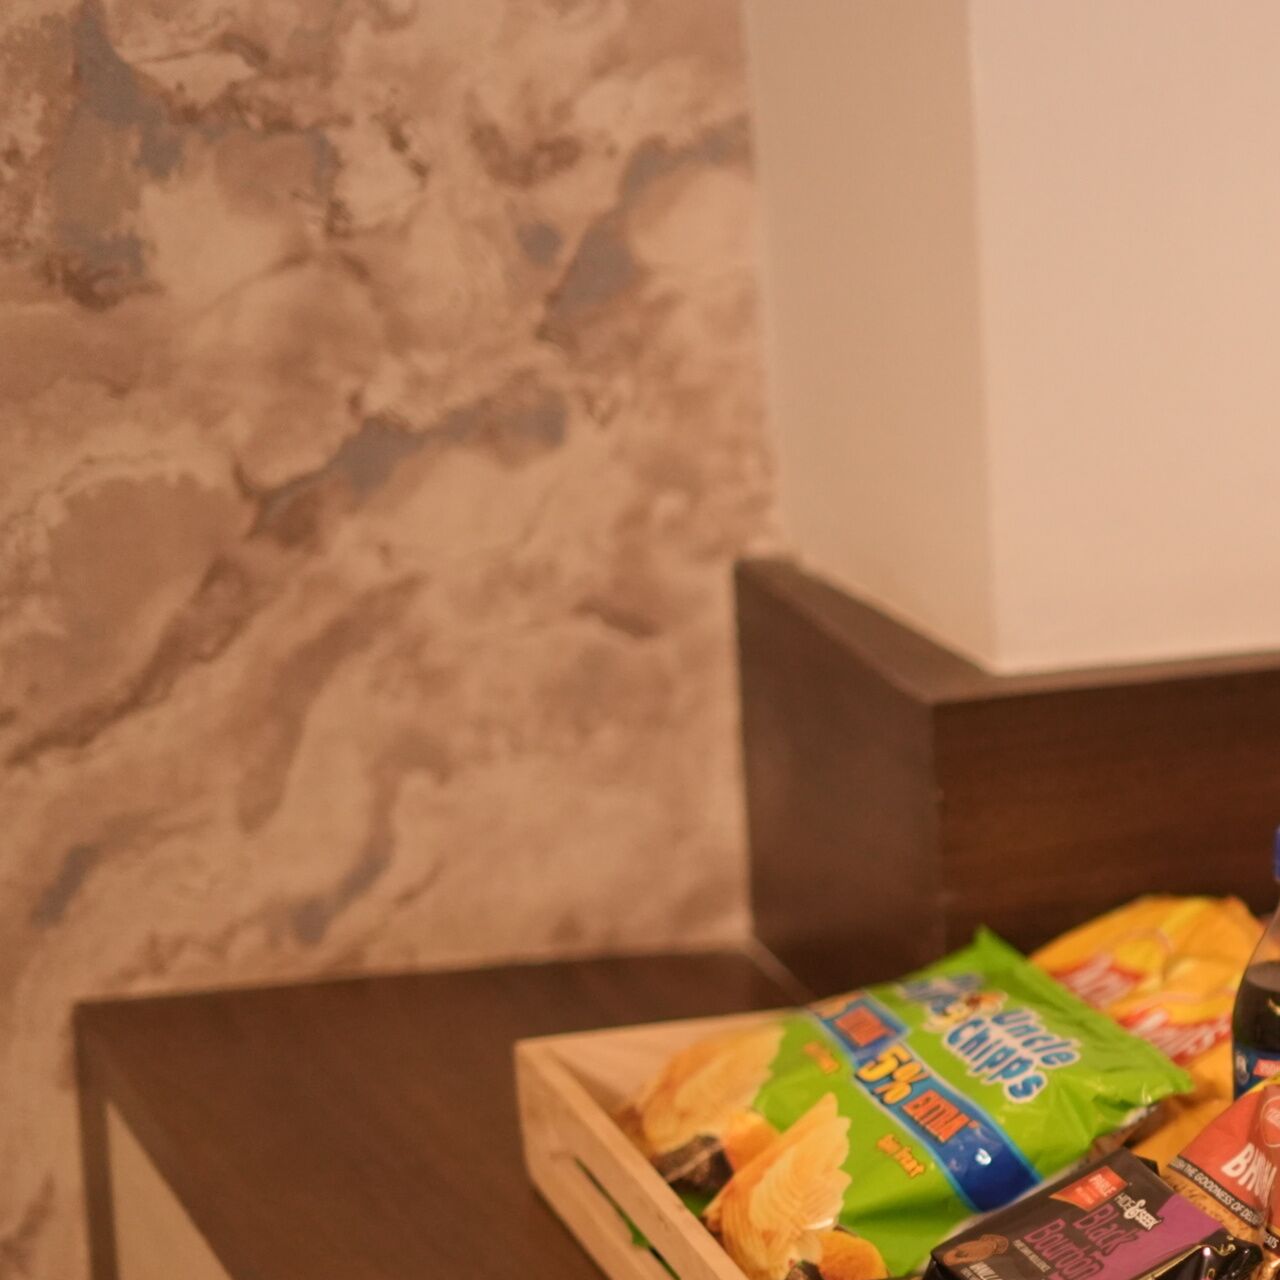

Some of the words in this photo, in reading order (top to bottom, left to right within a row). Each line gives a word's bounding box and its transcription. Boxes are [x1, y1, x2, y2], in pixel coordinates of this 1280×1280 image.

[944, 1015, 1048, 1104] Chipps
[991, 1008, 1083, 1069] Uncle
[854, 1045, 932, 1105] 5%
[1194, 1169, 1236, 1208] GOODNESS
[1230, 1199, 1246, 1216] OF
[1073, 1203, 1141, 1257] Black
